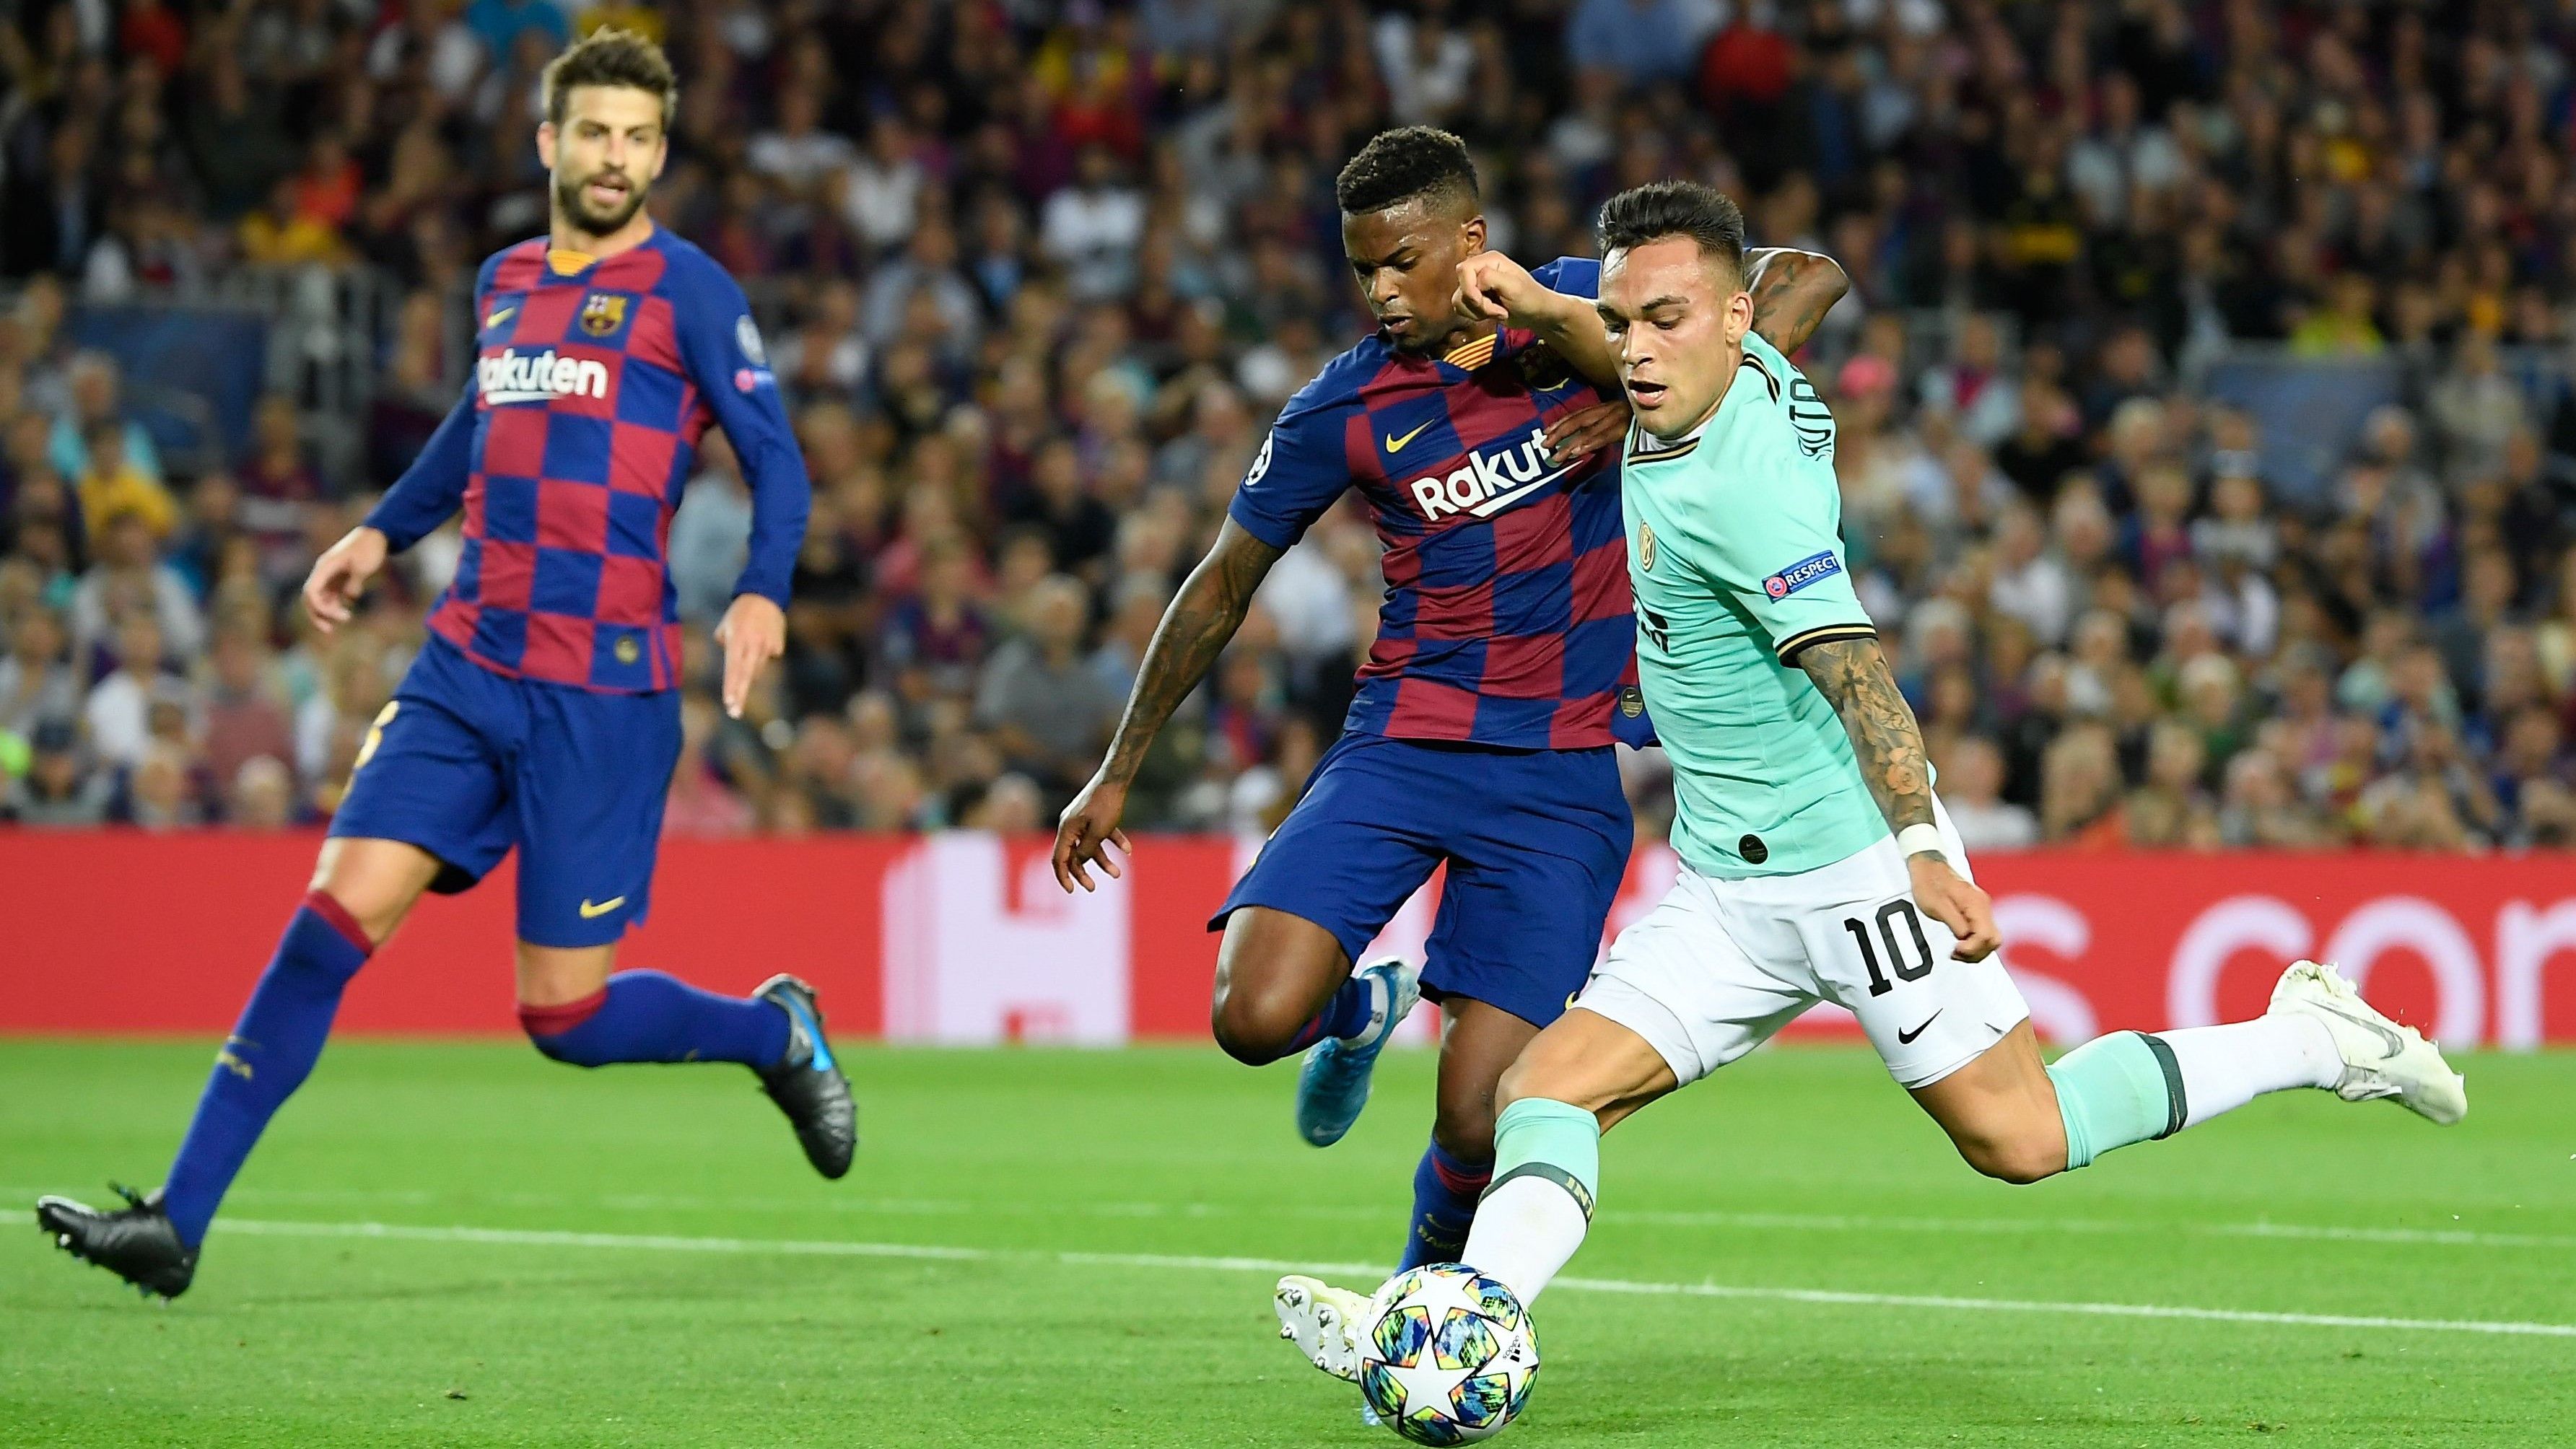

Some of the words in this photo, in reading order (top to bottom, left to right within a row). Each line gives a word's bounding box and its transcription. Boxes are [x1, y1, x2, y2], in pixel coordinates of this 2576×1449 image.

[1410, 428, 1578, 521] Rakut
[1785, 556, 1838, 587] RESPECT
[1844, 898, 1934, 998] 10
